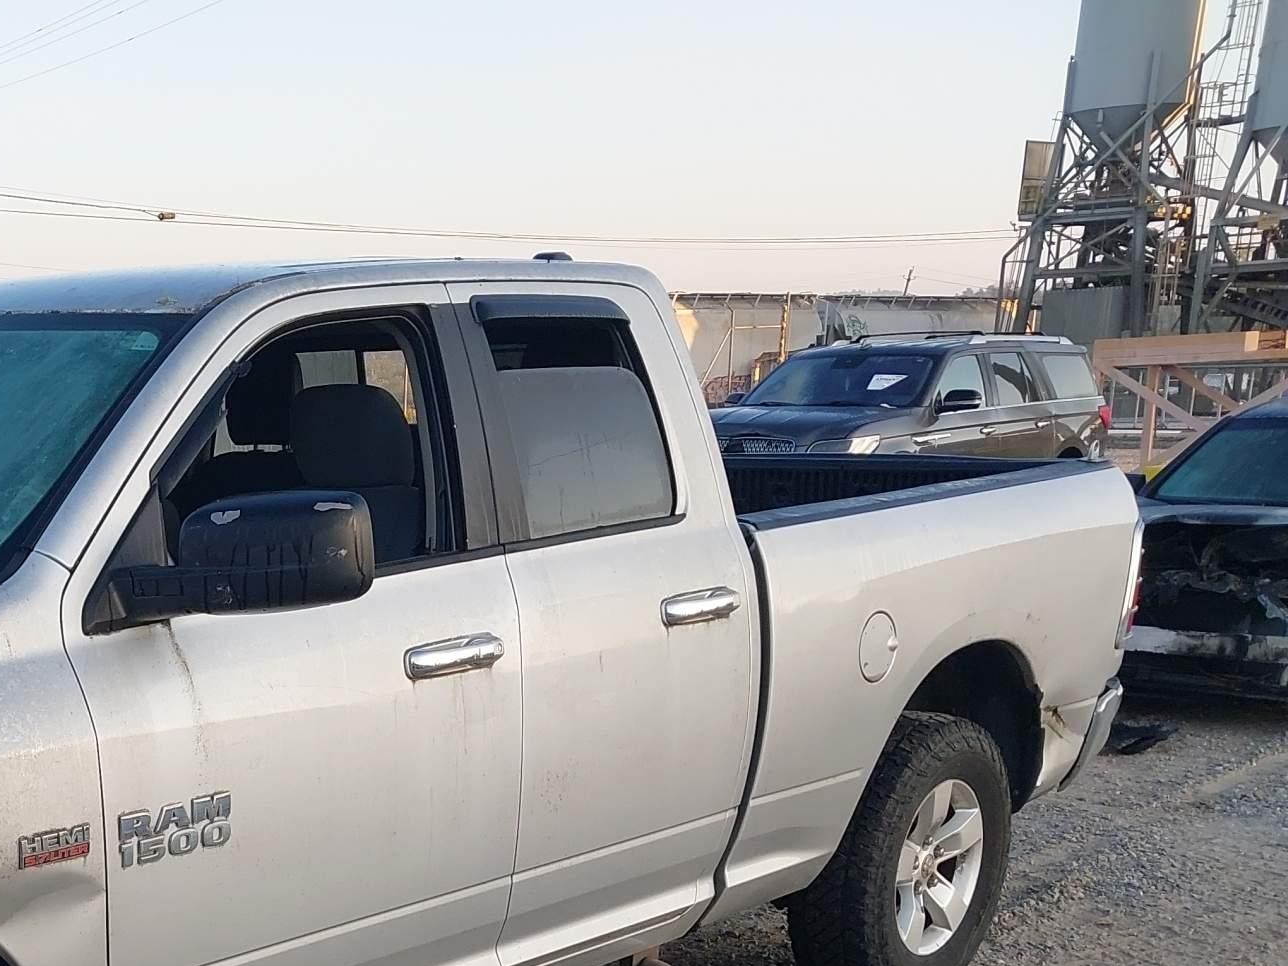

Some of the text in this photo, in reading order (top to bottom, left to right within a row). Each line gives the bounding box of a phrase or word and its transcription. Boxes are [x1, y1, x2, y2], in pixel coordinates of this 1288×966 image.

[18, 822, 90, 855] HEMI
[118, 791, 231, 842] RAM
[119, 820, 231, 869] 1500
